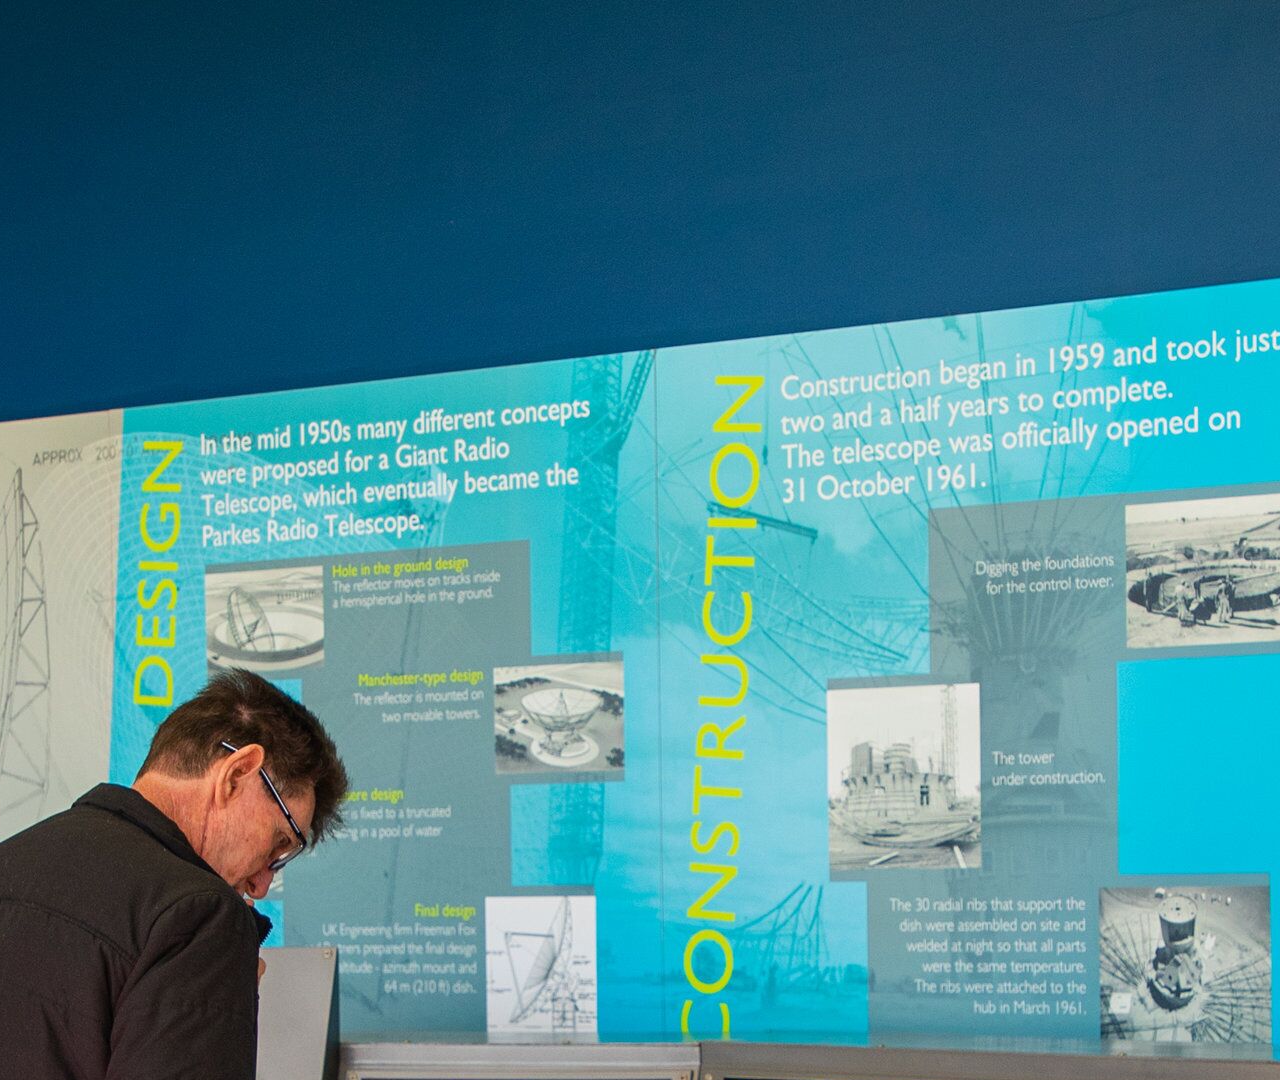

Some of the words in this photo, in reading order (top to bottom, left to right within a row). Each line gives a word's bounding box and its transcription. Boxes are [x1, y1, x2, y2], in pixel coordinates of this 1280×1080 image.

[781, 367, 931, 401] Construction
[940, 359, 1007, 393] began
[1014, 351, 1037, 379] in
[1049, 343, 1105, 374] 1959
[1114, 338, 1157, 366] and
[1167, 332, 1227, 362] took
[781, 414, 826, 434] two
[832, 402, 873, 431] and
[880, 407, 894, 428] a
[900, 394, 943, 425] half
[947, 396, 1010, 428] years
[1019, 393, 1044, 413] to
[1053, 378, 1173, 412] complete.
[199, 436, 217, 455] In
[222, 434, 252, 453] the
[257, 426, 291, 450] mid
[300, 419, 352, 448] 1950s
[357, 420, 410, 448] many
[413, 408, 496, 435] different
[501, 399, 591, 428] concepts
[782, 445, 825, 470] The
[832, 434, 941, 467] telescope
[949, 433, 993, 453] was
[1001, 417, 1098, 452] officially
[1108, 406, 1199, 448] opened
[1209, 411, 1241, 431] on
[32, 448, 83, 466] APPROX
[200, 467, 249, 486] were
[250, 452, 339, 484] proposed
[345, 449, 372, 473] for
[379, 453, 390, 471] a
[395, 444, 448, 468] Giant
[454, 438, 511, 463] Radio
[201, 492, 298, 518] Telescope,
[303, 483, 358, 507] which
[363, 474, 459, 505] eventually
[464, 470, 540, 496] became
[546, 462, 579, 488] the
[783, 477, 805, 504] 31
[817, 471, 915, 501] October
[927, 463, 986, 492] 1961.
[202, 523, 261, 548] Parkes
[267, 517, 318, 544] Radio
[324, 512, 425, 539] Telescope.
[133, 440, 184, 708] DESIGN
[331, 565, 357, 577] Hole
[361, 565, 371, 576] in
[373, 562, 390, 576] the
[393, 559, 432, 577] ground
[435, 558, 468, 573] design
[976, 558, 1019, 579] Digging
[1022, 556, 1041, 573] the
[1044, 553, 1115, 571] foundations
[986, 580, 1003, 595] for
[1006, 580, 1026, 594] the
[1029, 576, 1071, 593] control
[1075, 576, 1114, 590] tower.
[680, 375, 764, 1042] CONSTRUCTION
[992, 751, 1015, 765] The
[1018, 753, 1055, 764] tower
[992, 771, 1027, 787] under
[1029, 770, 1105, 785] construction.
[973, 1000, 997, 1016] hub
[999, 1002, 1010, 1014] in
[1013, 999, 1051, 1015] March
[1056, 1000, 1087, 1016] 1961.
